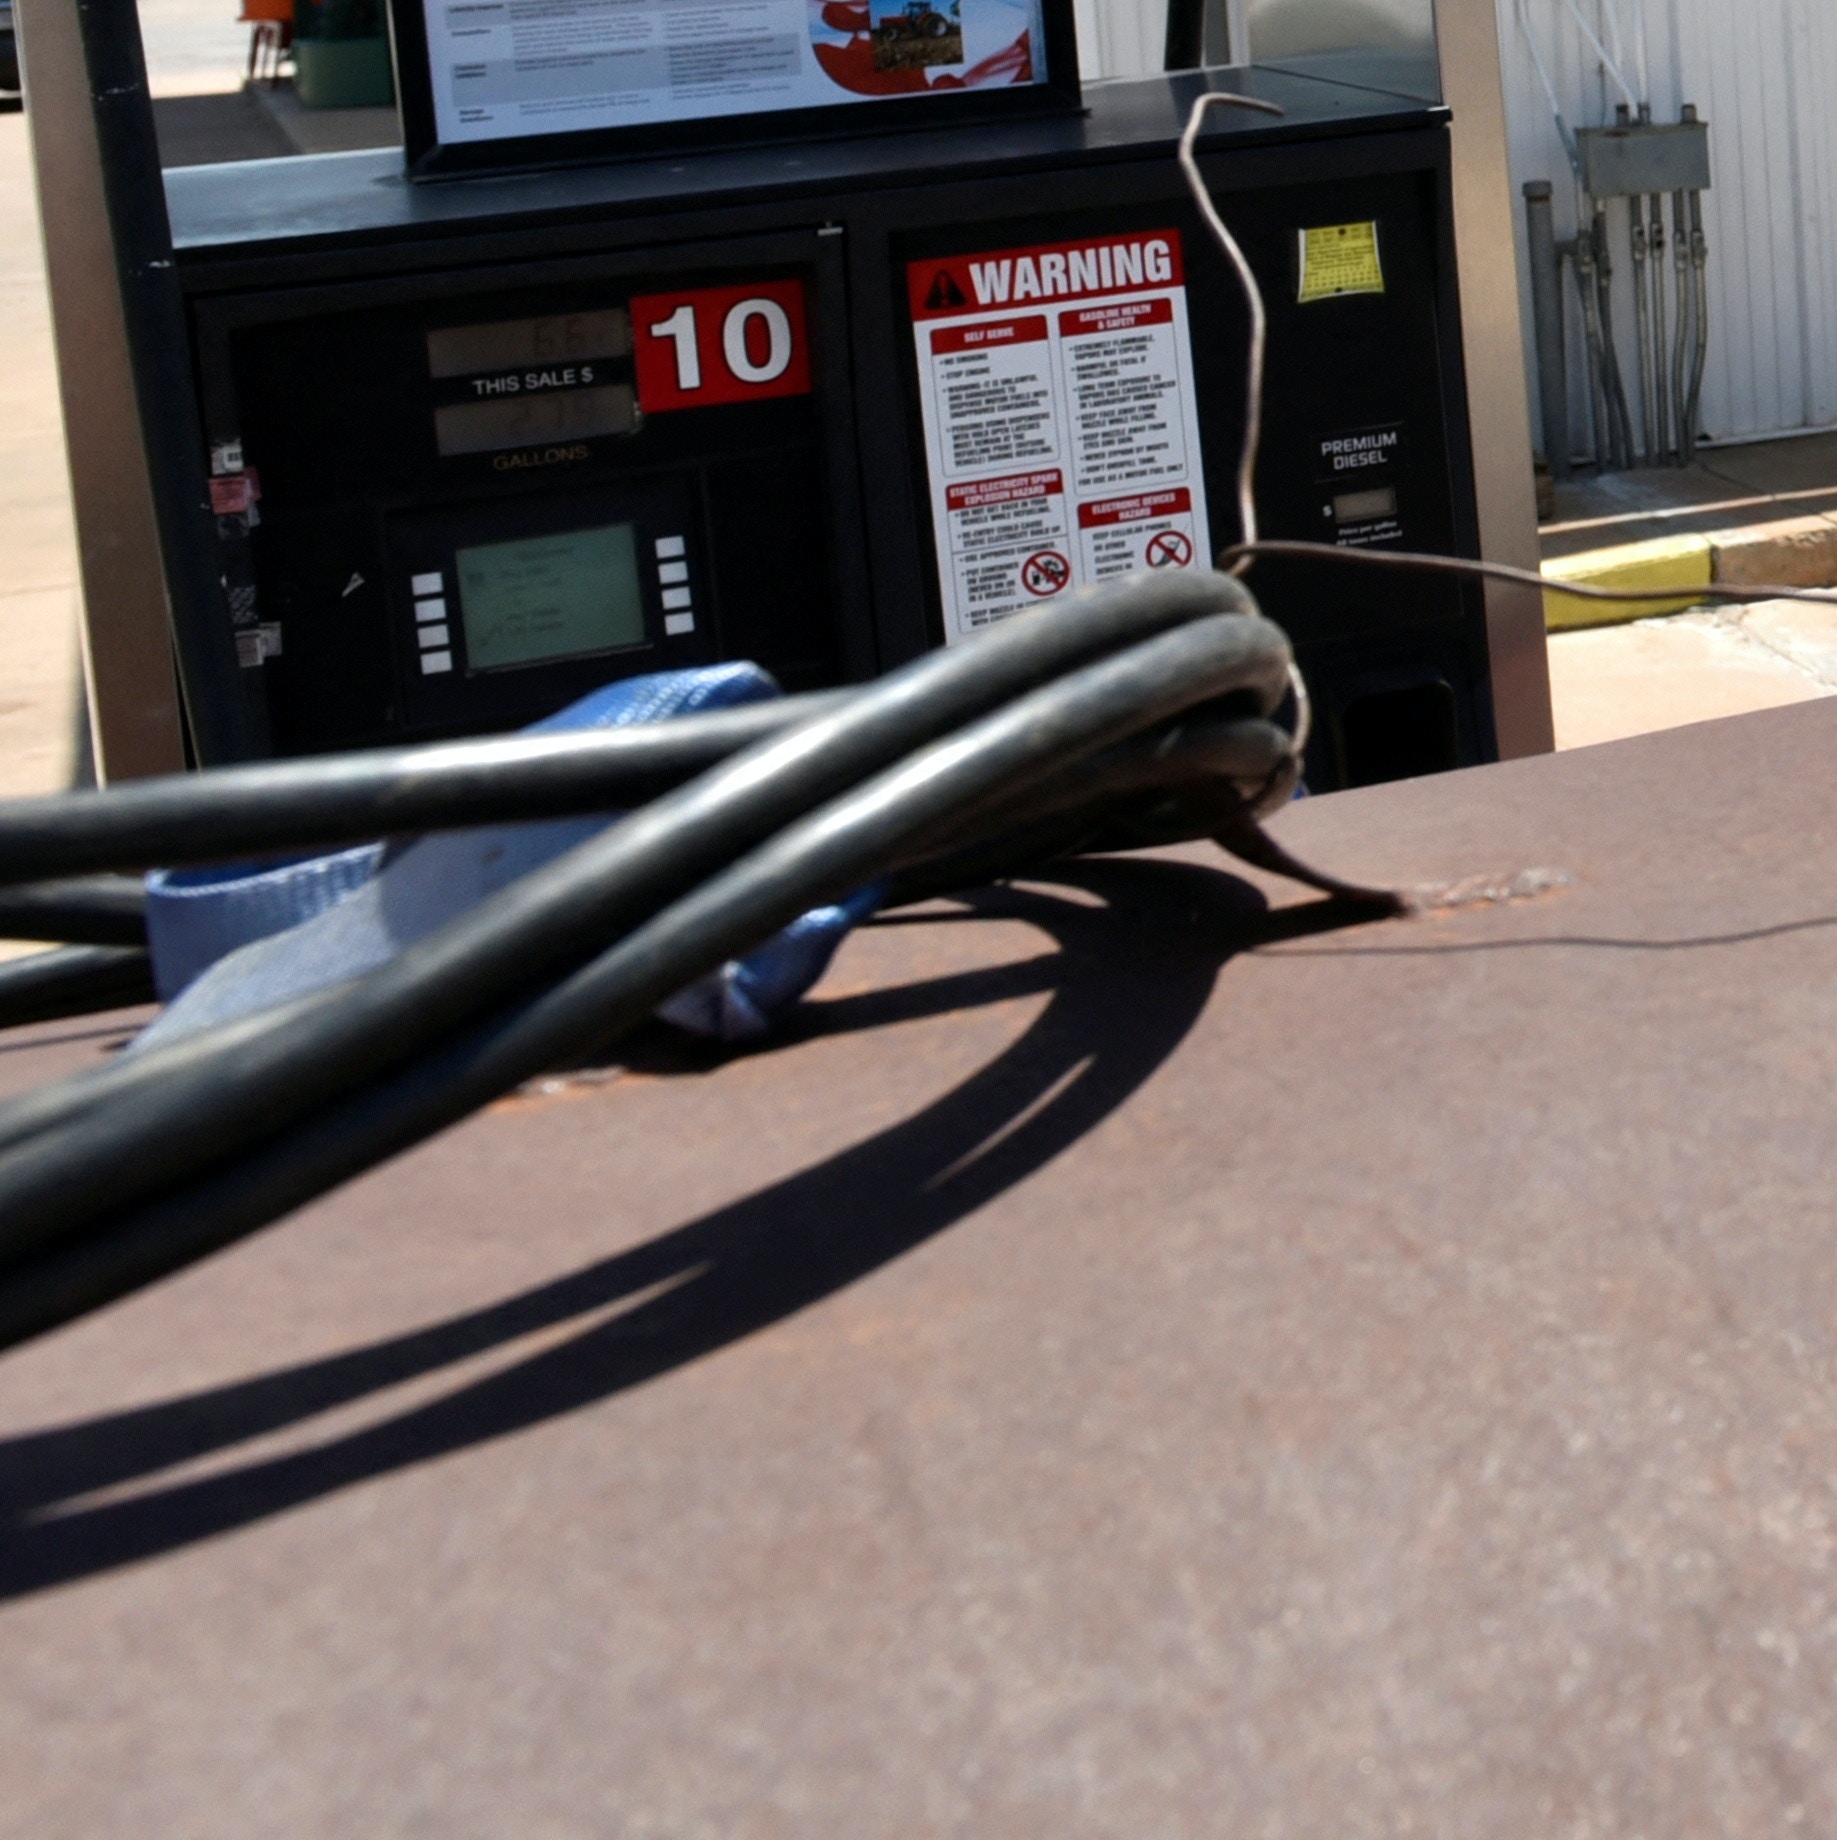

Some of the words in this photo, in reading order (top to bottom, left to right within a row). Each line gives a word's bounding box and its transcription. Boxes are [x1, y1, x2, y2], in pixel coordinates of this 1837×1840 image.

[969, 239, 1172, 305] WARNING
[650, 298, 792, 391] 10
[472, 375, 521, 396] THIS
[524, 371, 577, 392] SALE
[580, 366, 595, 384] $
[493, 444, 590, 472] GALLONS
[1321, 431, 1398, 456] PREMIUM
[1333, 450, 1388, 470] DIESEL
